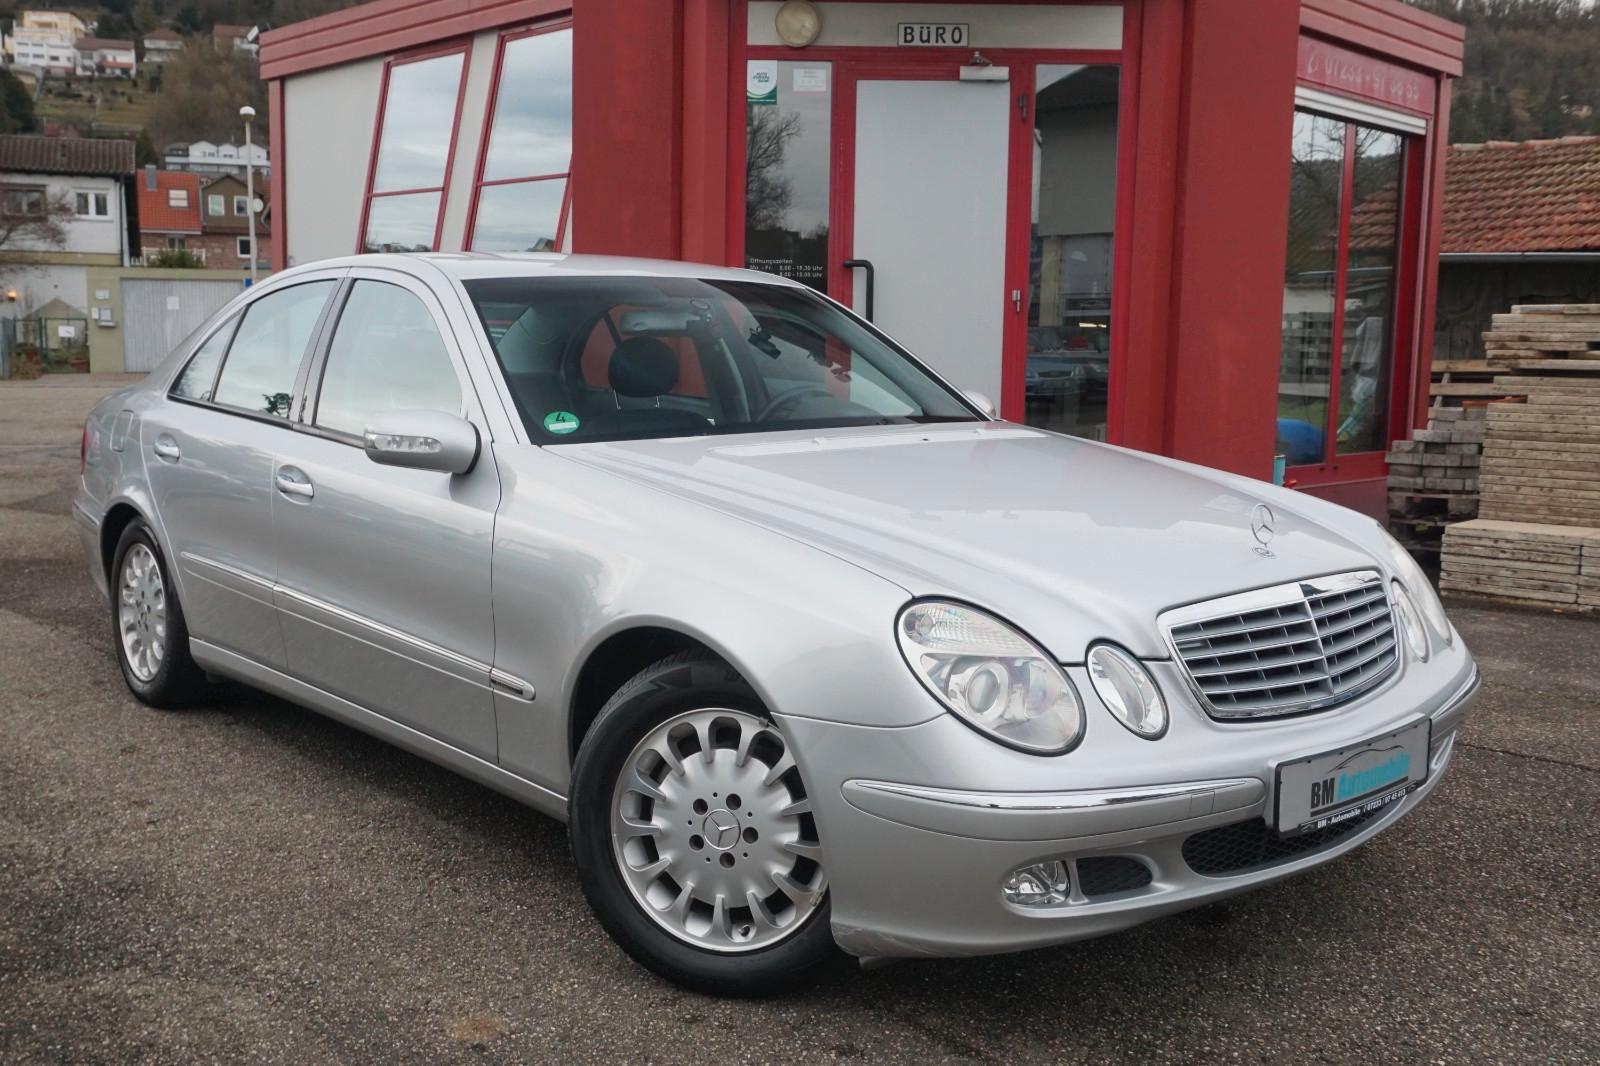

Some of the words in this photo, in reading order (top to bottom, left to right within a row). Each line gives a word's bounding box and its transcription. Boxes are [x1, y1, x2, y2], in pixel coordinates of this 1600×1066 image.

[556, 412, 566, 423] 4
[1317, 818, 1327, 829] BM
[1331, 808, 1361, 825] Automobile
